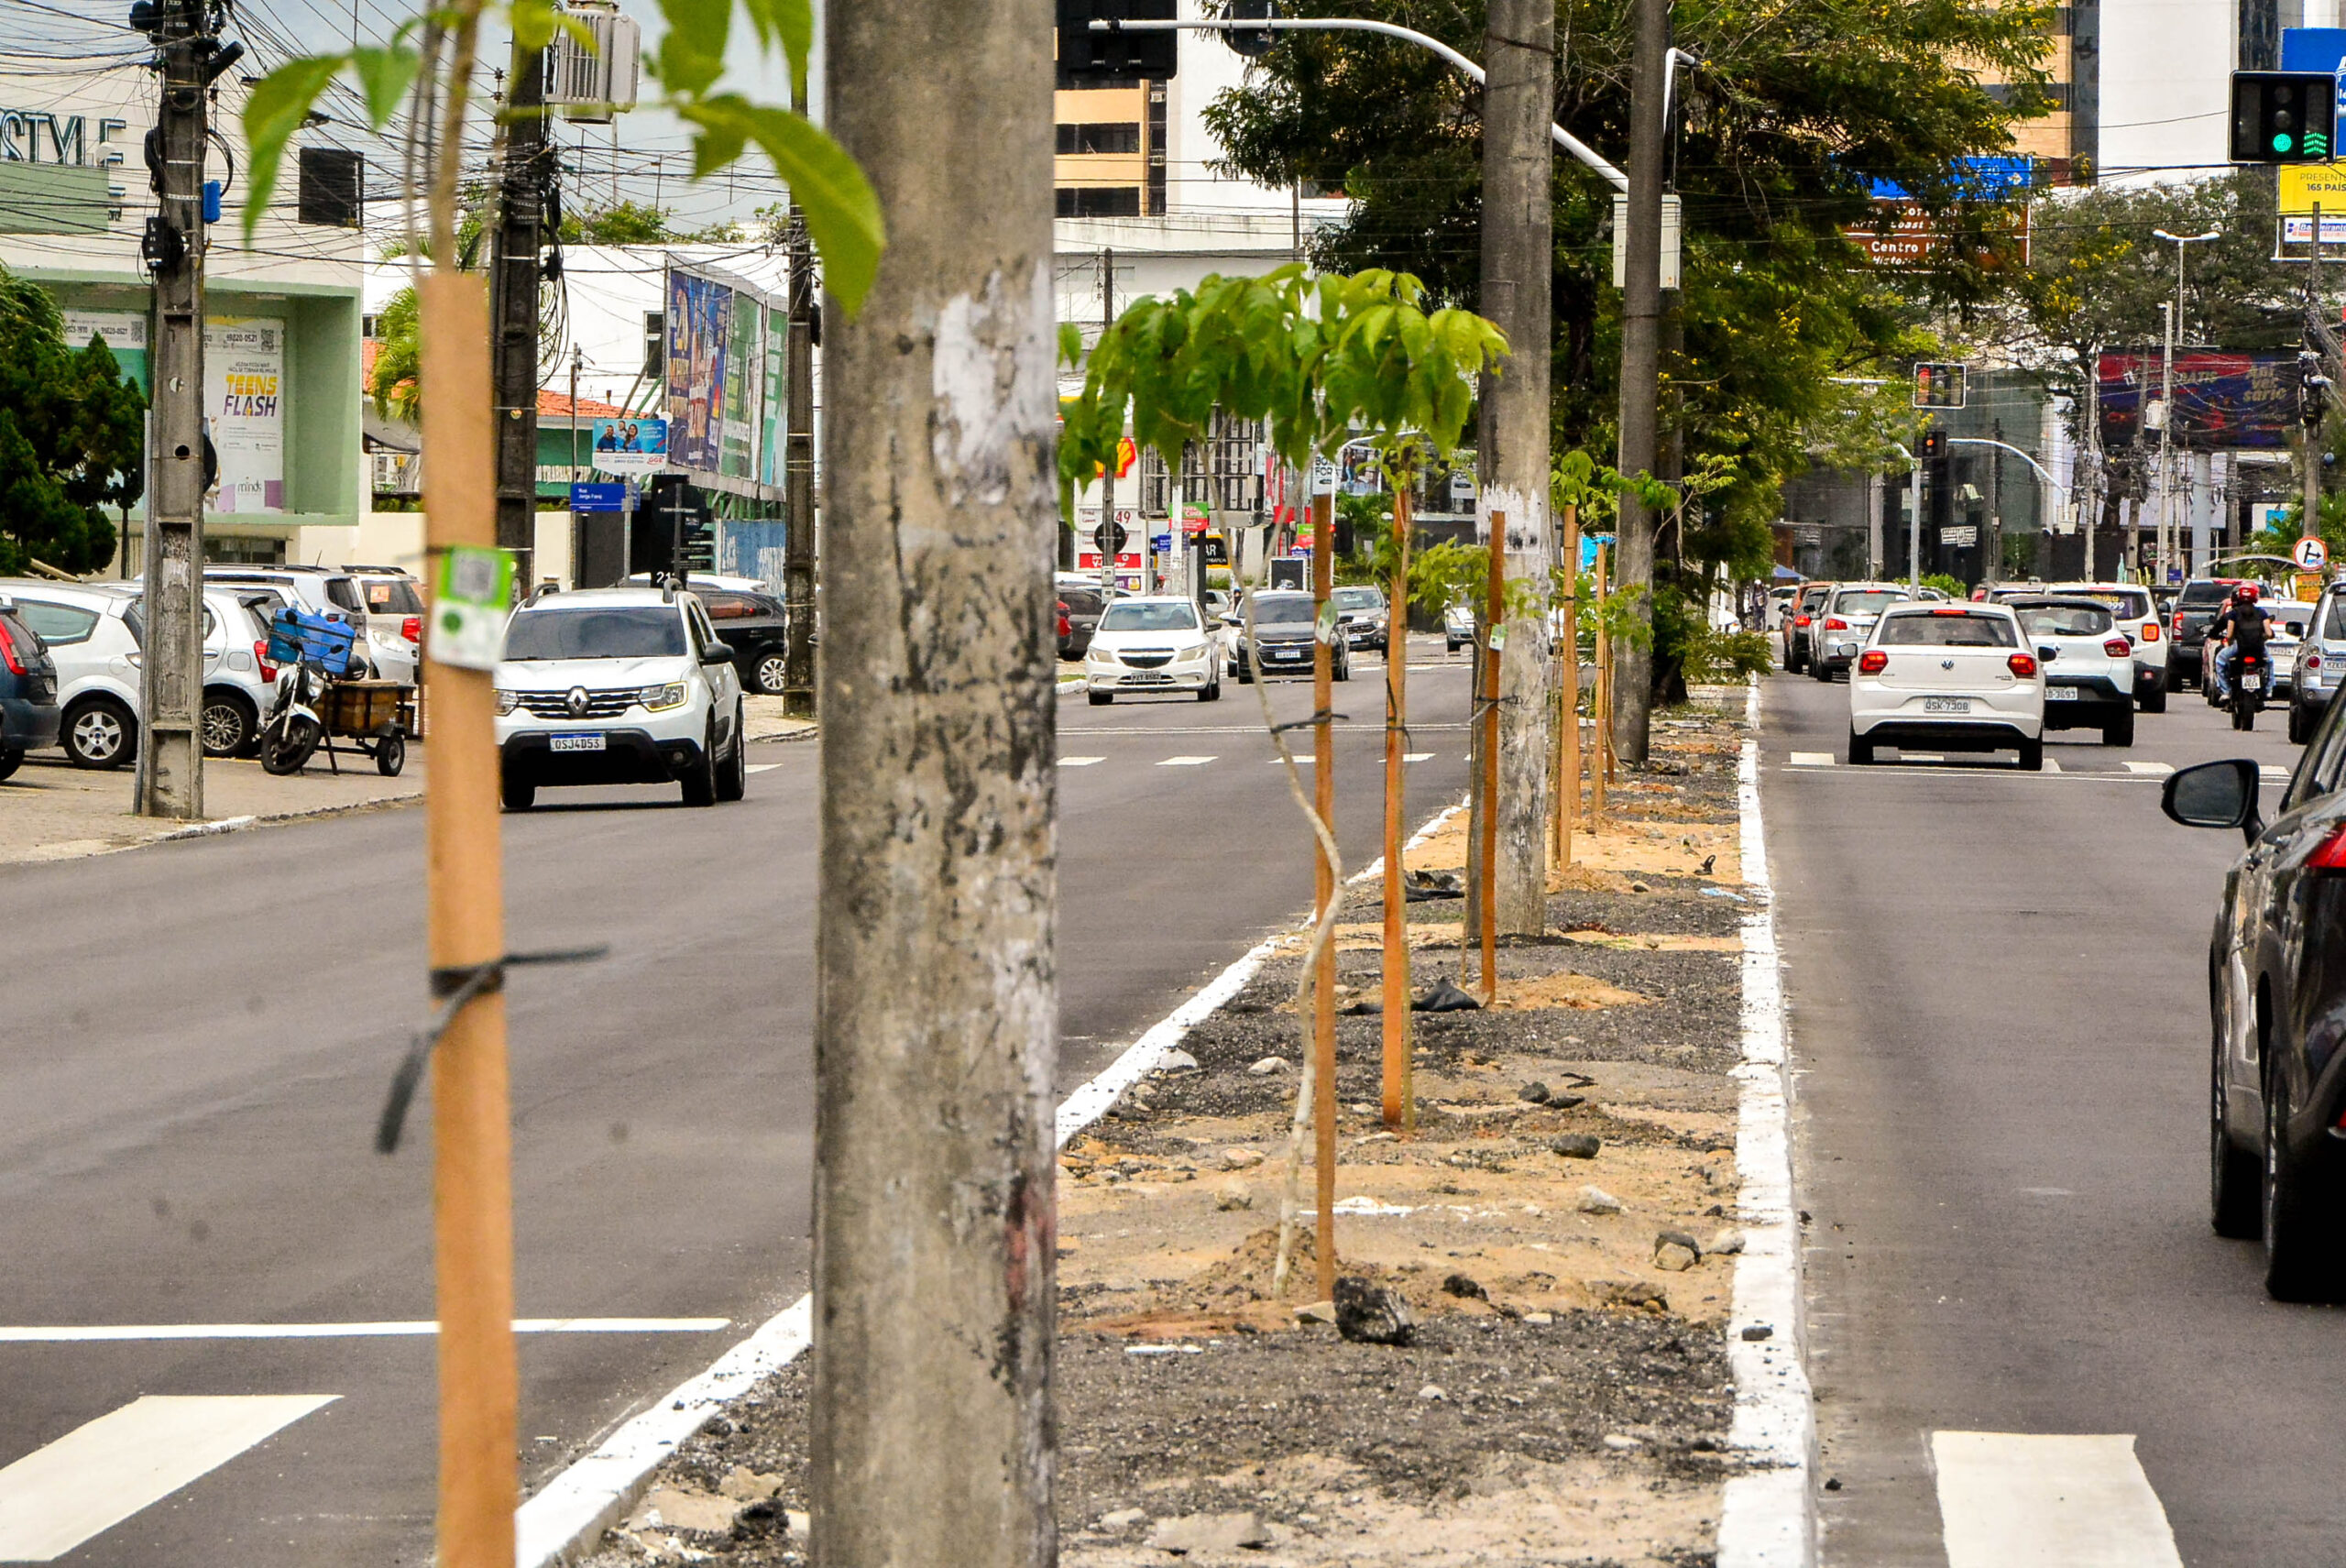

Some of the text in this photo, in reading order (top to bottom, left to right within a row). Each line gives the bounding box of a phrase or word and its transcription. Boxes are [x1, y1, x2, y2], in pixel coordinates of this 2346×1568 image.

[2308, 183, 2321, 192] 165
[1871, 241, 1919, 254] Centro
[225, 375, 279, 395] TEENS
[224, 395, 278, 417] FLASH
[1115, 510, 1131, 523] 49
[1925, 700, 1968, 710] QSK-7308
[555, 739, 600, 750] QSJ4D53
